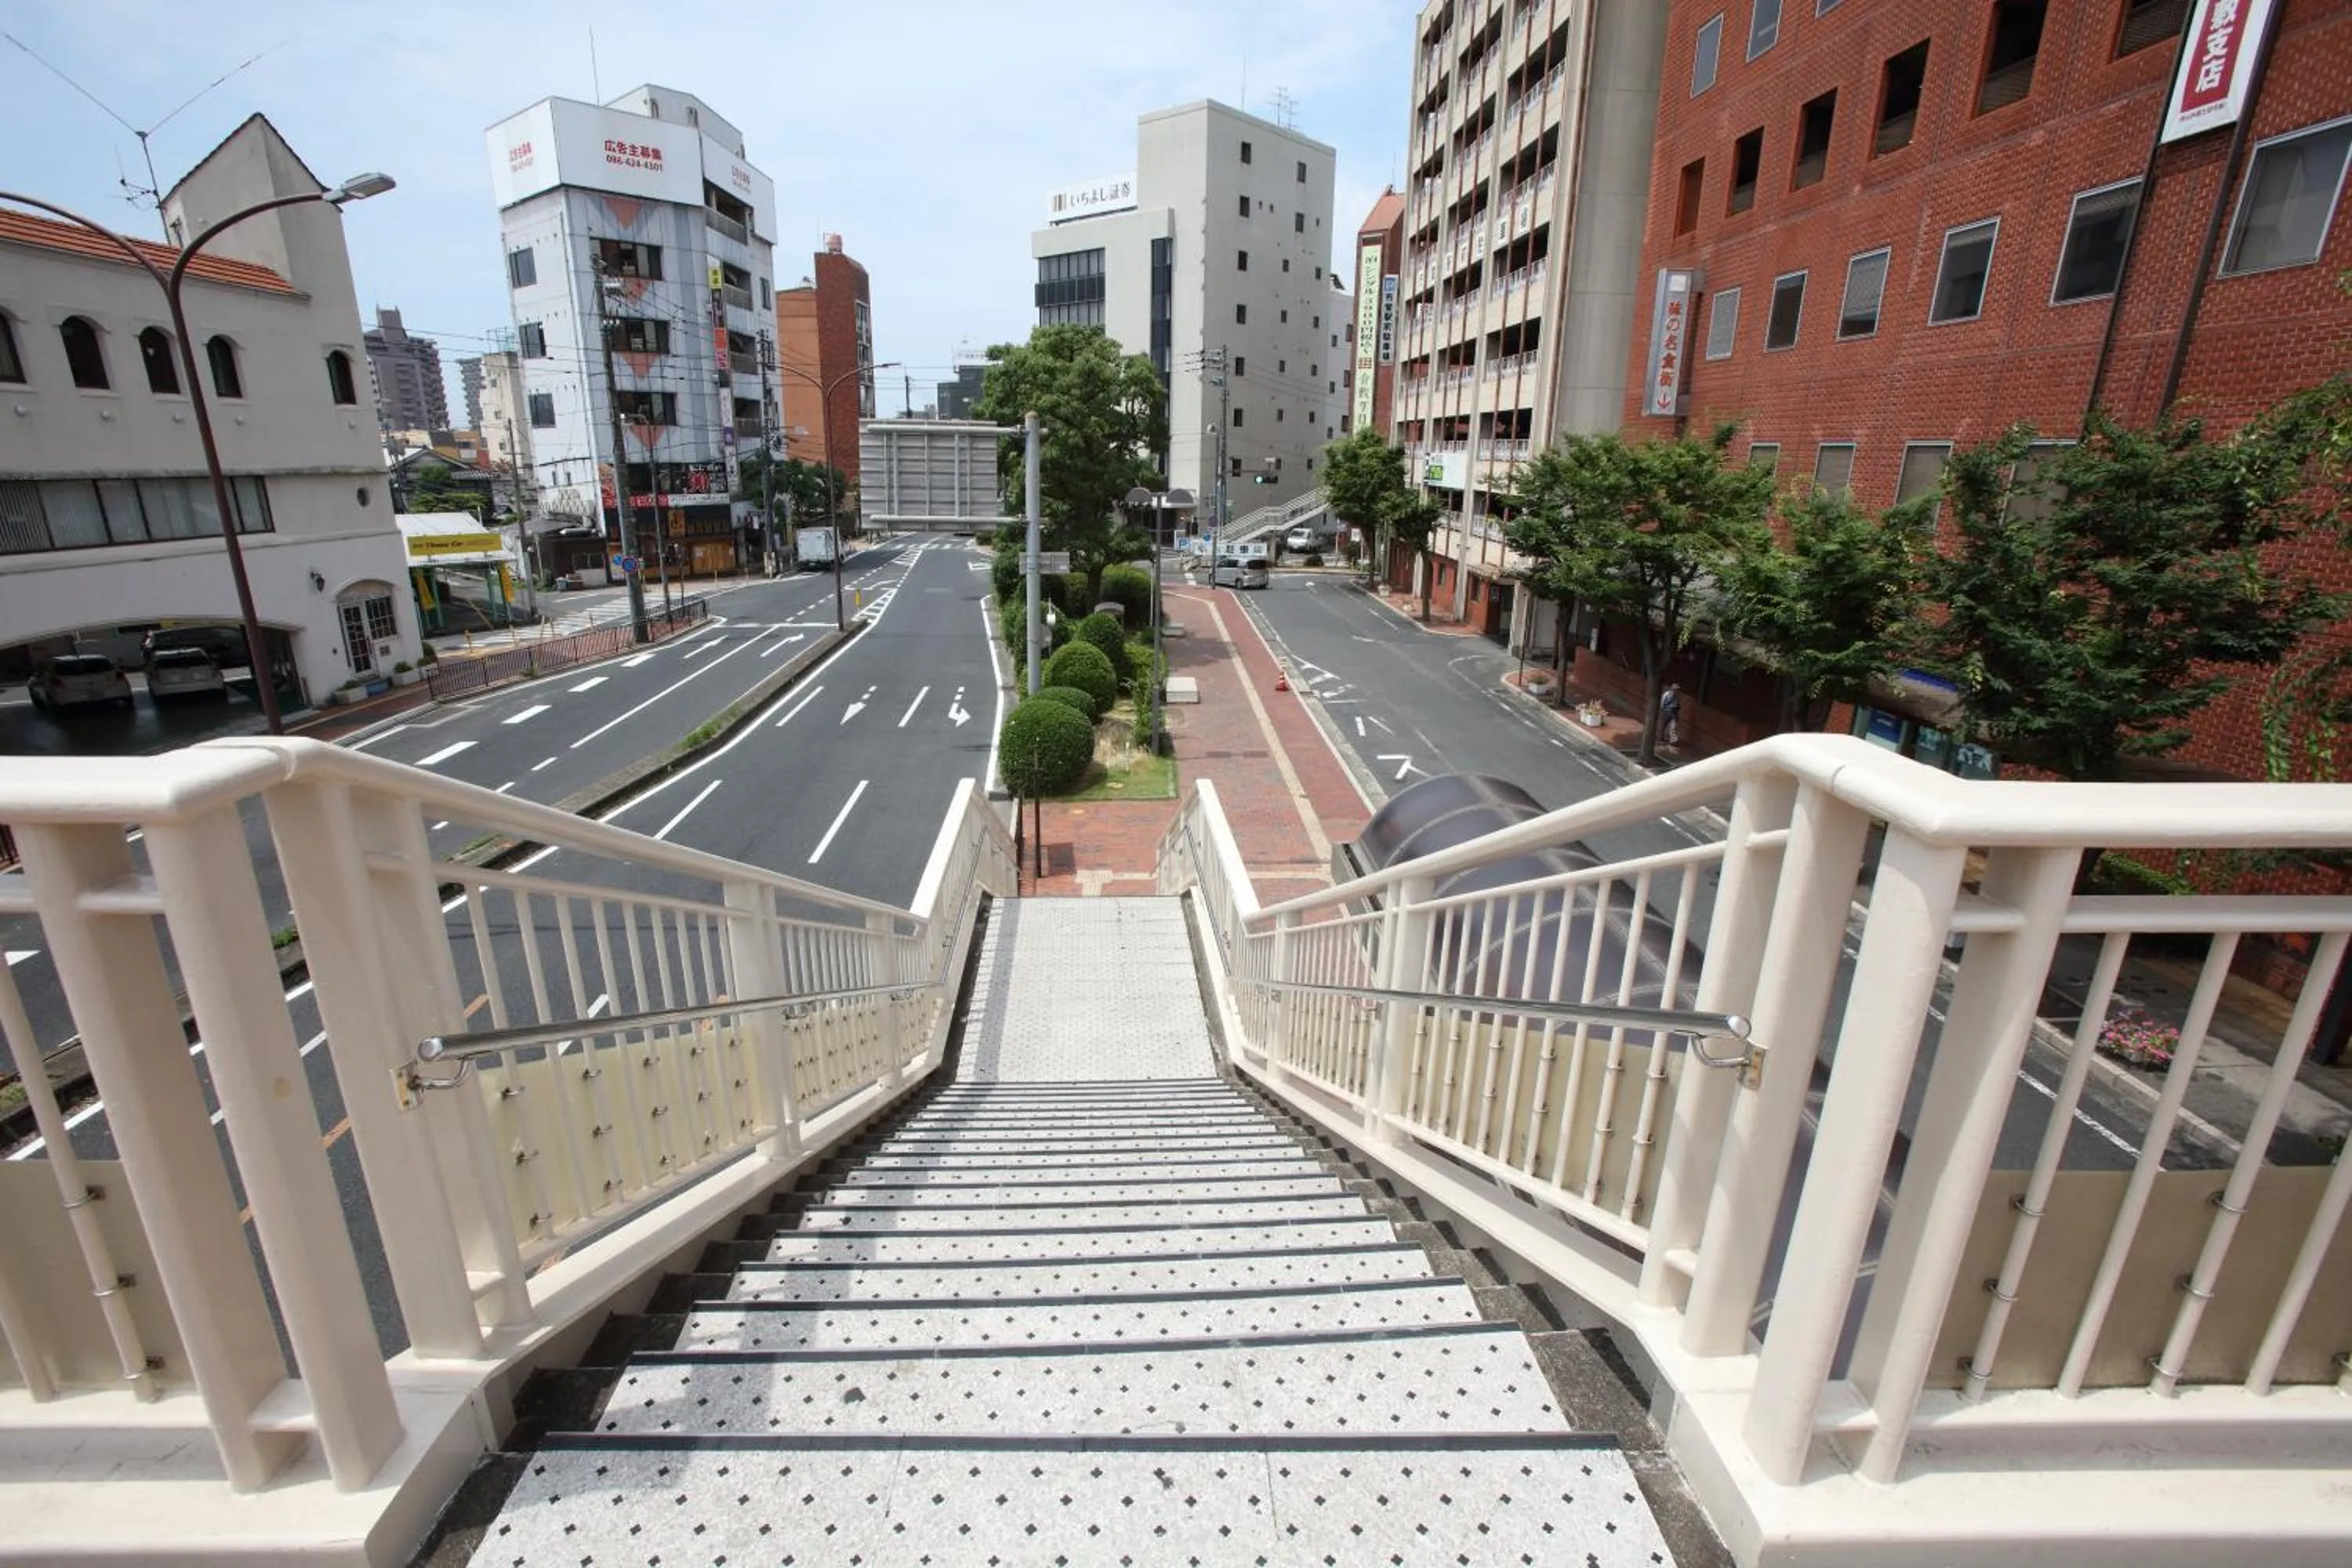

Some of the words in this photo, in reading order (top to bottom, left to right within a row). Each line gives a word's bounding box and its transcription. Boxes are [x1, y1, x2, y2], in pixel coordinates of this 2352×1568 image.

[604, 139, 662, 161] 広告主募集
[1070, 181, 1130, 208] いちよし証券
